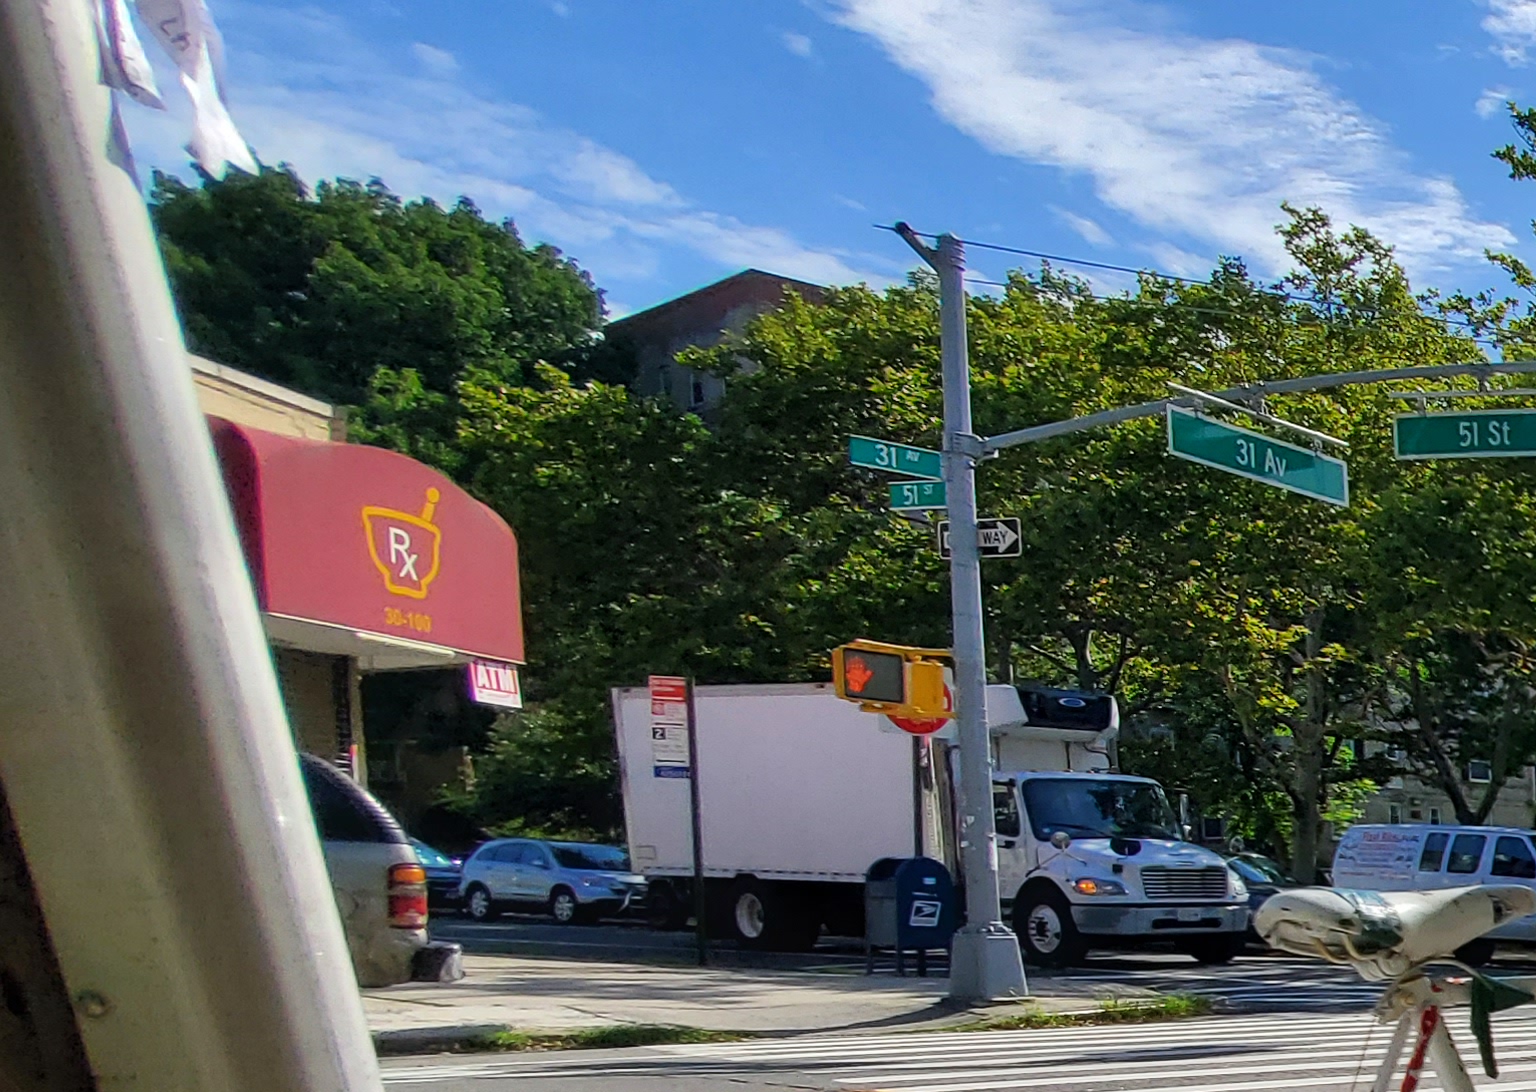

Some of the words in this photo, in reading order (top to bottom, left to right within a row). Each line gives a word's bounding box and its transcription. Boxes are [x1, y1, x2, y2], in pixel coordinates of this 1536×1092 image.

[1459, 420, 1478, 448] 51
[1488, 420, 1511, 447] St
[875, 444, 897, 468] 31
[1236, 438, 1256, 469] 31
[1264, 446, 1288, 478] Av
[903, 484, 919, 506] 51
[923, 484, 934, 496] ST
[982, 530, 1009, 546] WAY
[388, 526, 419, 582] Rx
[475, 662, 518, 695] ATM
